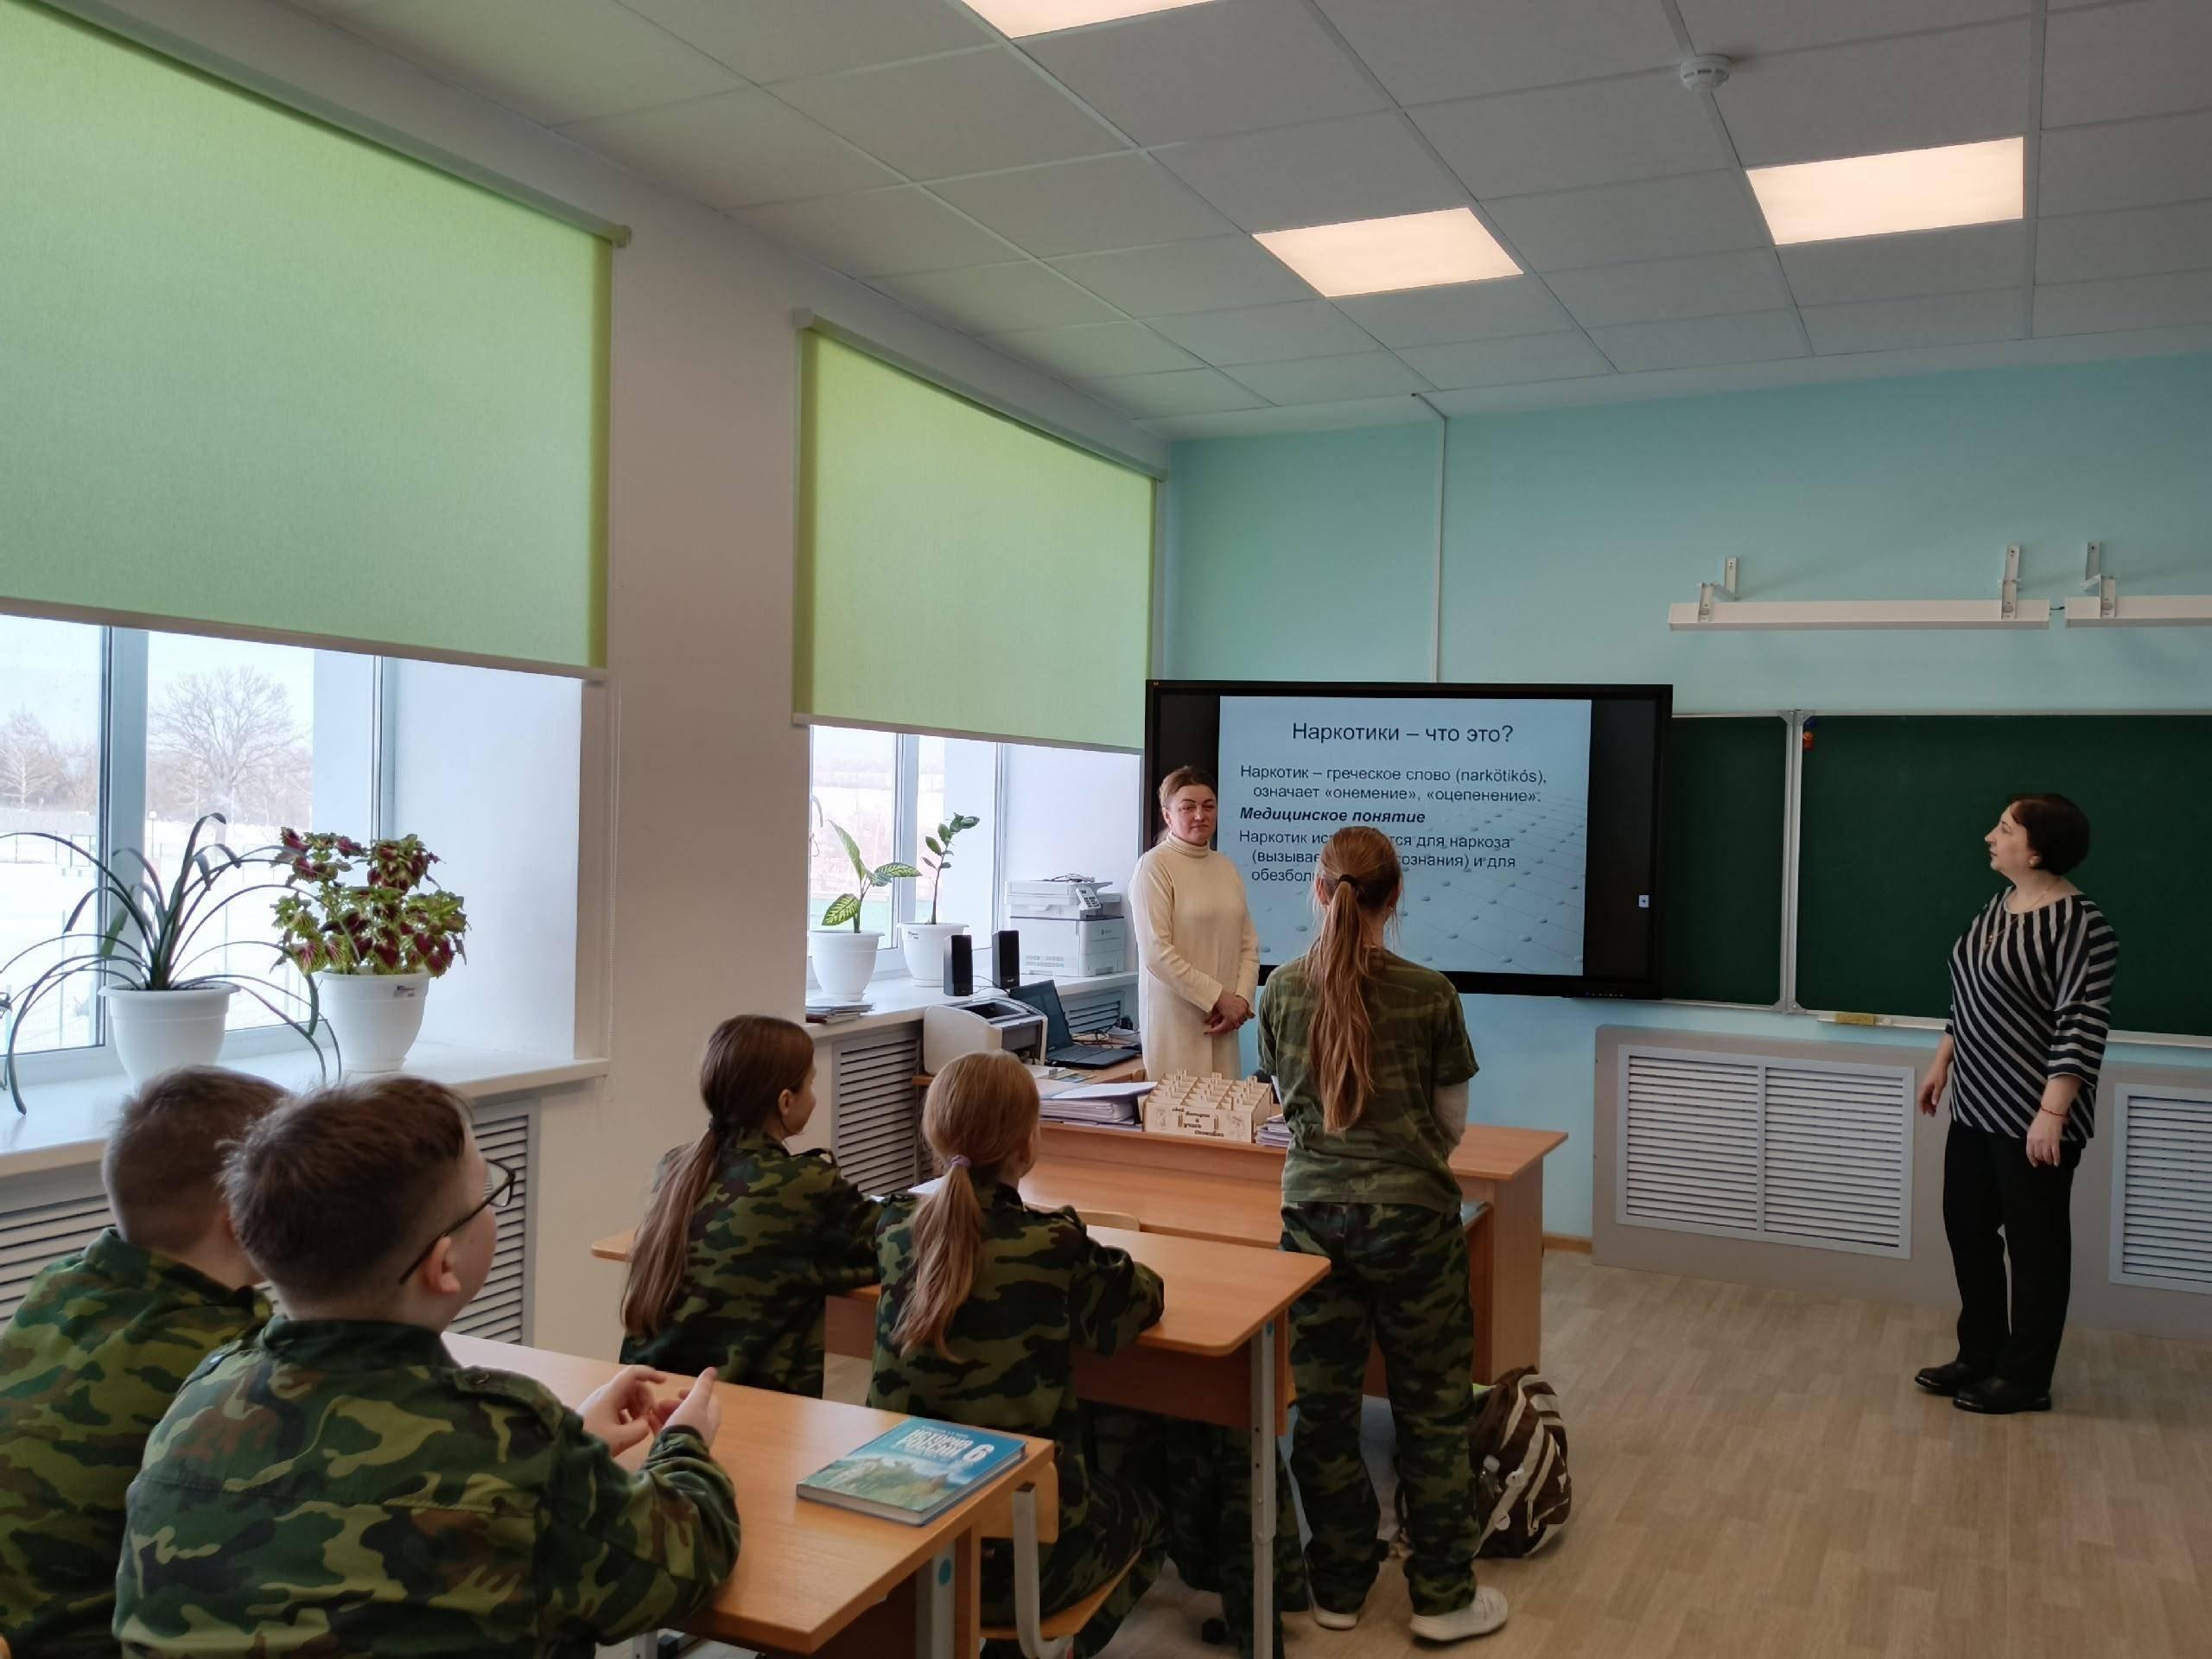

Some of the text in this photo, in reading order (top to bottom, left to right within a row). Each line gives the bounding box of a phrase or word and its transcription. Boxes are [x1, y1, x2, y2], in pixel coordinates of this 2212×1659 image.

[1292, 722, 1400, 744] Наркотики
[1426, 728, 1460, 742] что
[1466, 724, 1514, 743] это?
[1240, 764, 1310, 780] Наркотик
[1326, 768, 1402, 781] греческое
[1406, 769, 1451, 781] слово
[1253, 786, 1320, 798] означает
[1325, 787, 1421, 802] «онемение»,
[1239, 806, 1426, 823] Медицинское понятие
[1239, 830, 1308, 845] Наркотик
[1415, 836, 1446, 849] для
[1450, 836, 1510, 850] наркоза
[1473, 856, 1483, 868] и
[1486, 857, 1516, 869] для
